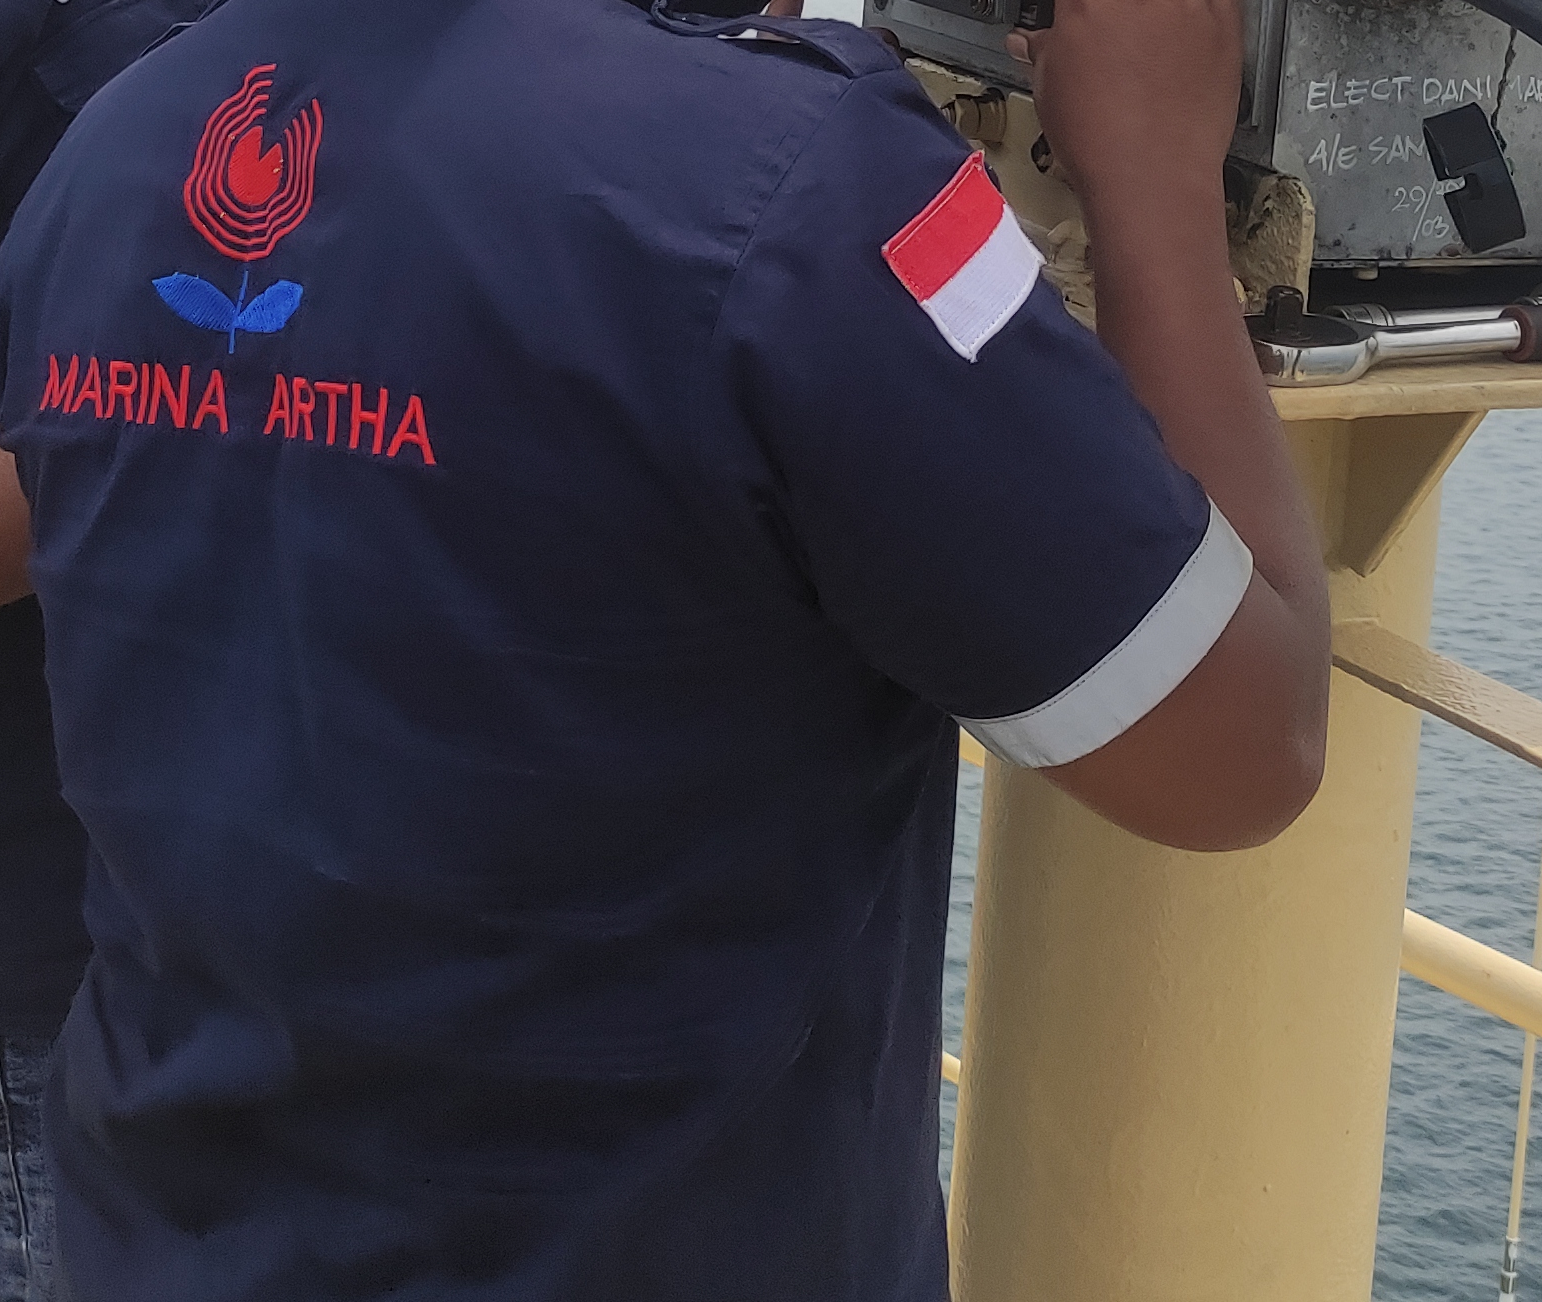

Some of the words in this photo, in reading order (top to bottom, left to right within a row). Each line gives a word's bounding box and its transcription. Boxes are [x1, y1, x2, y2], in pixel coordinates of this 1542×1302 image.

[1308, 73, 1412, 111] ELECT
[1423, 75, 1491, 105] DANI
[1309, 133, 1358, 176] A/E
[39, 354, 229, 434] MARINA
[263, 373, 436, 465] ARTHA
